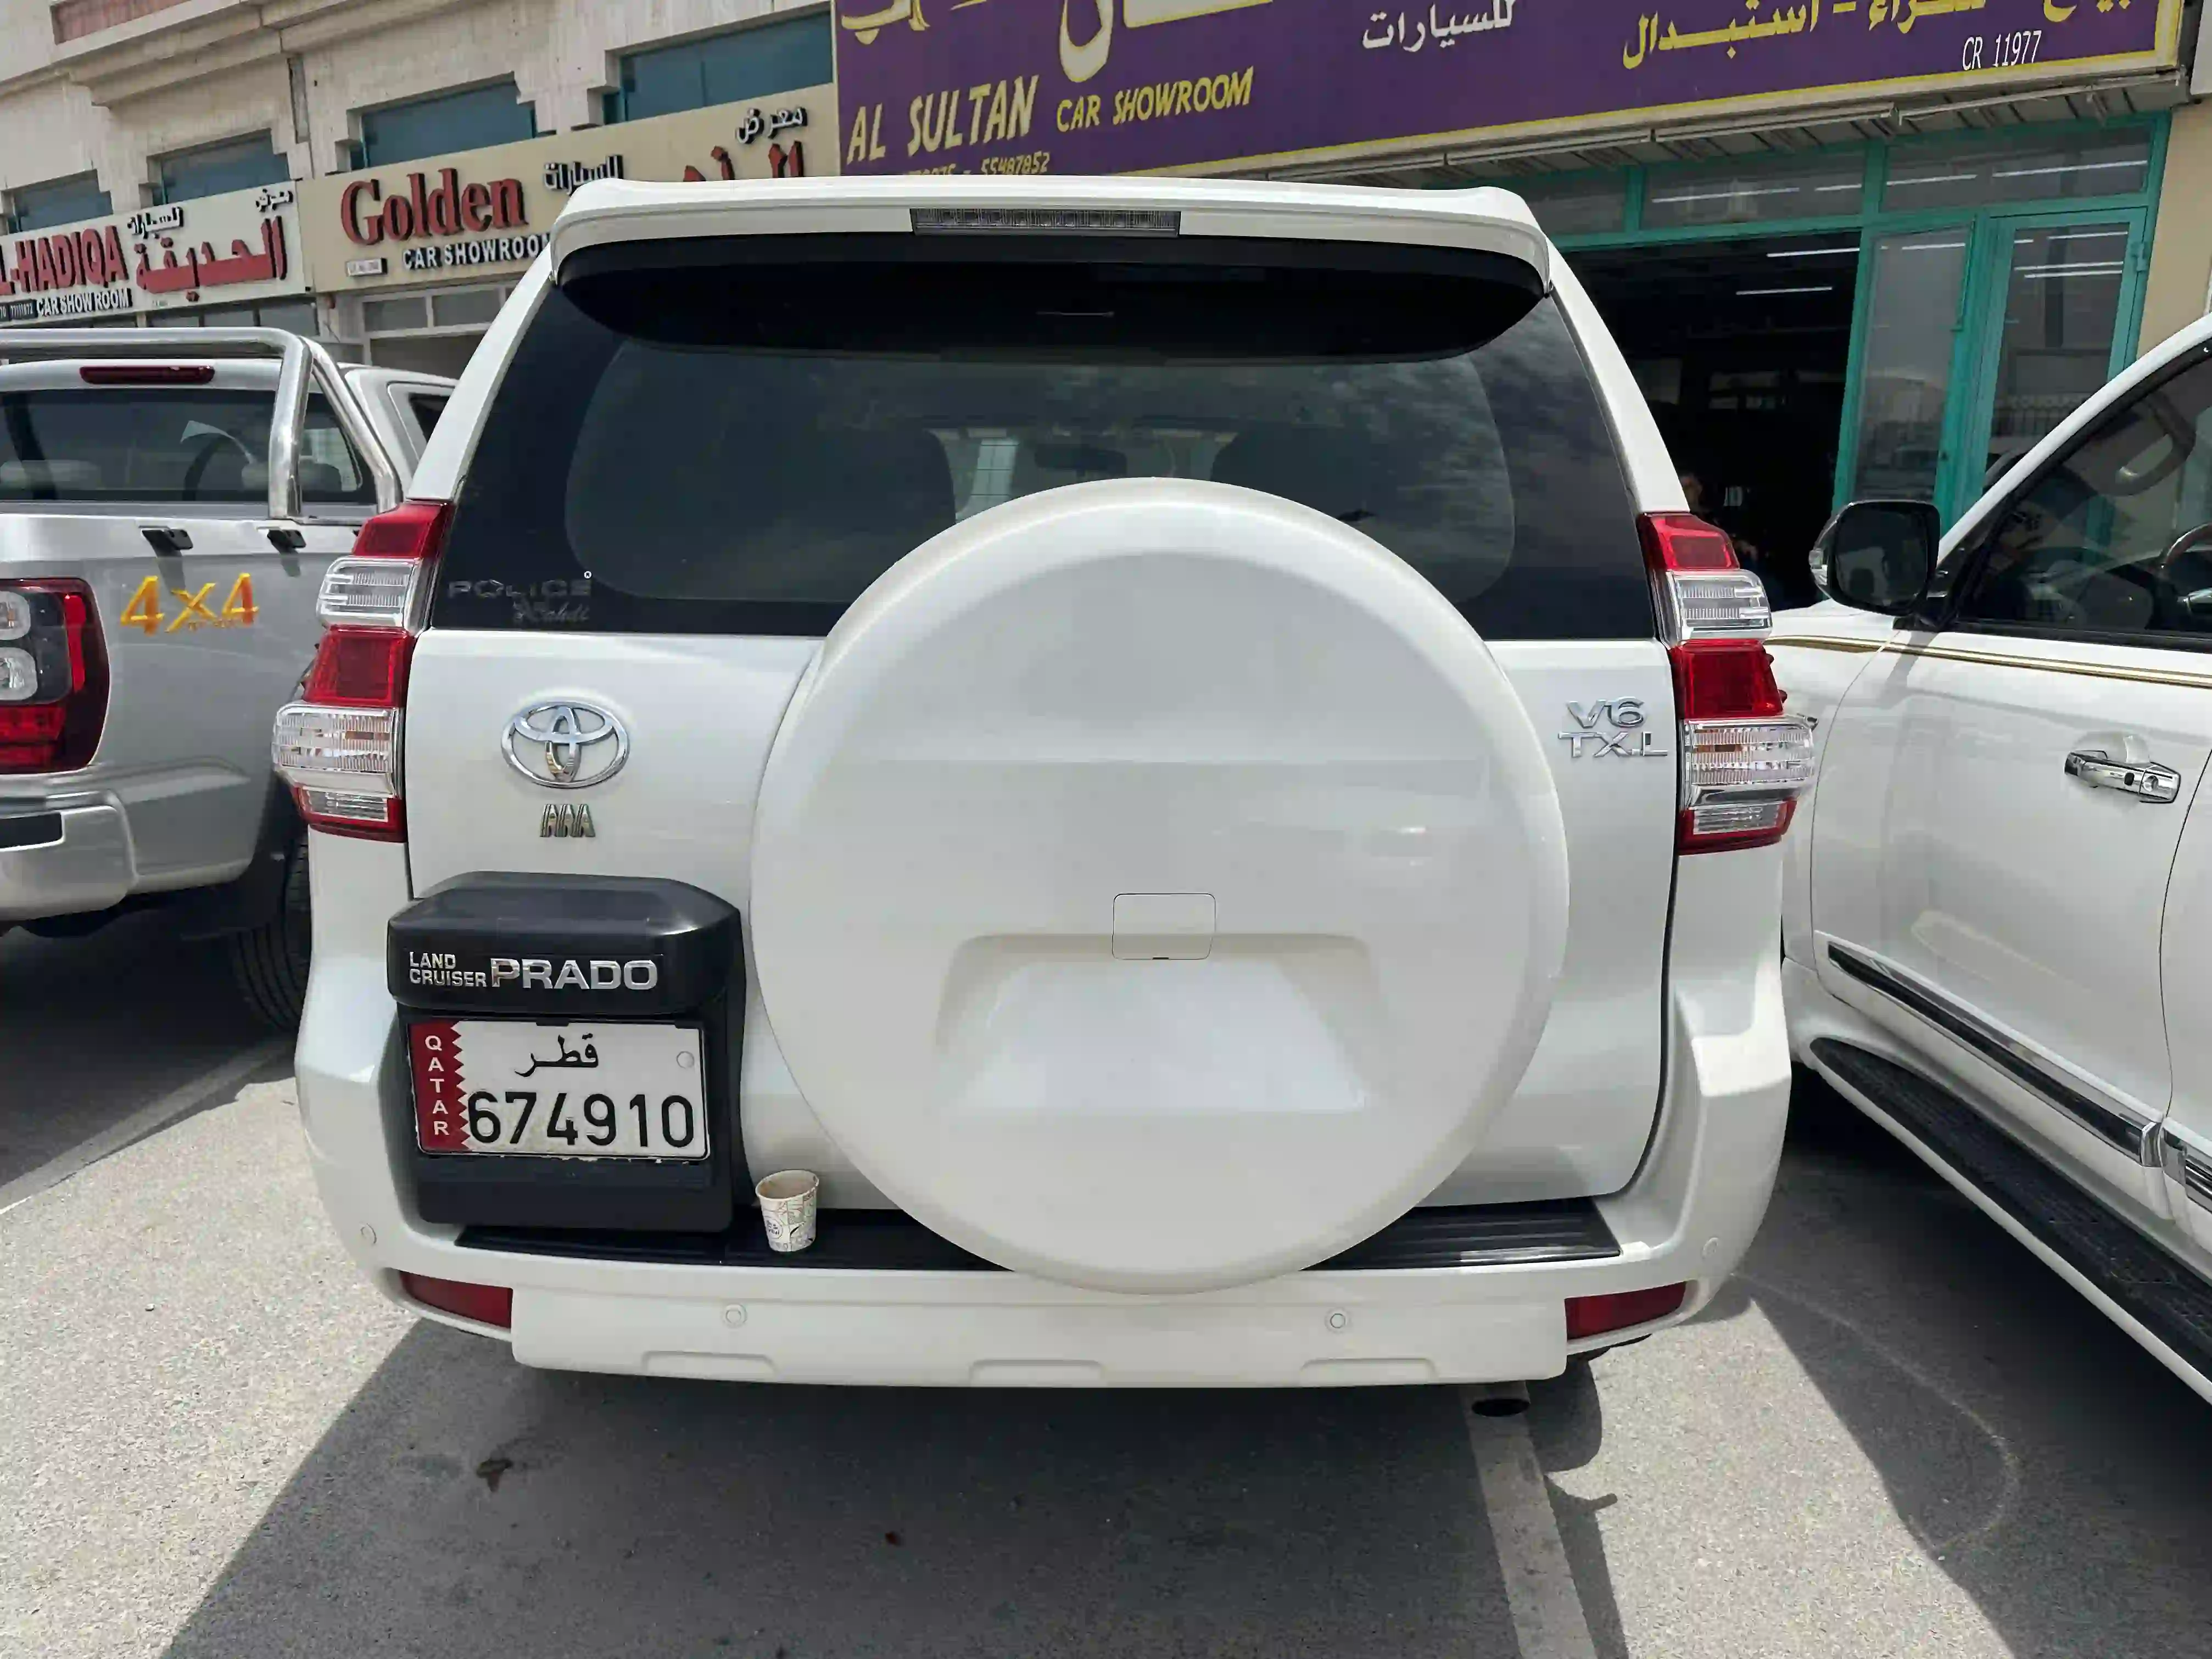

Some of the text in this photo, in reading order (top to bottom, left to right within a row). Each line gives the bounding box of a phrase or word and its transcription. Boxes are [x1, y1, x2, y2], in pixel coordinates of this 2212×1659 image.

[1962, 30, 2042, 71] CR 11977
[734, 107, 807, 144] معرض
[846, 103, 886, 165] AL
[907, 75, 1040, 158] SULTAN
[1055, 94, 1102, 133] CAR
[1113, 65, 1254, 126] SHOWROOM
[340, 167, 529, 245] Golden
[136, 215, 288, 300] الحديقة
[402, 244, 442, 270] CAR
[36, 297, 60, 317] CAR
[1566, 696, 1644, 728] V6
[409, 951, 455, 969] LAND
[409, 969, 487, 987] CRUISER
[490, 958, 658, 990] PRADO
[514, 1032, 599, 1078] قطر
[424, 1035, 450, 1136] QATAR
[467, 1091, 695, 1148] 674910
